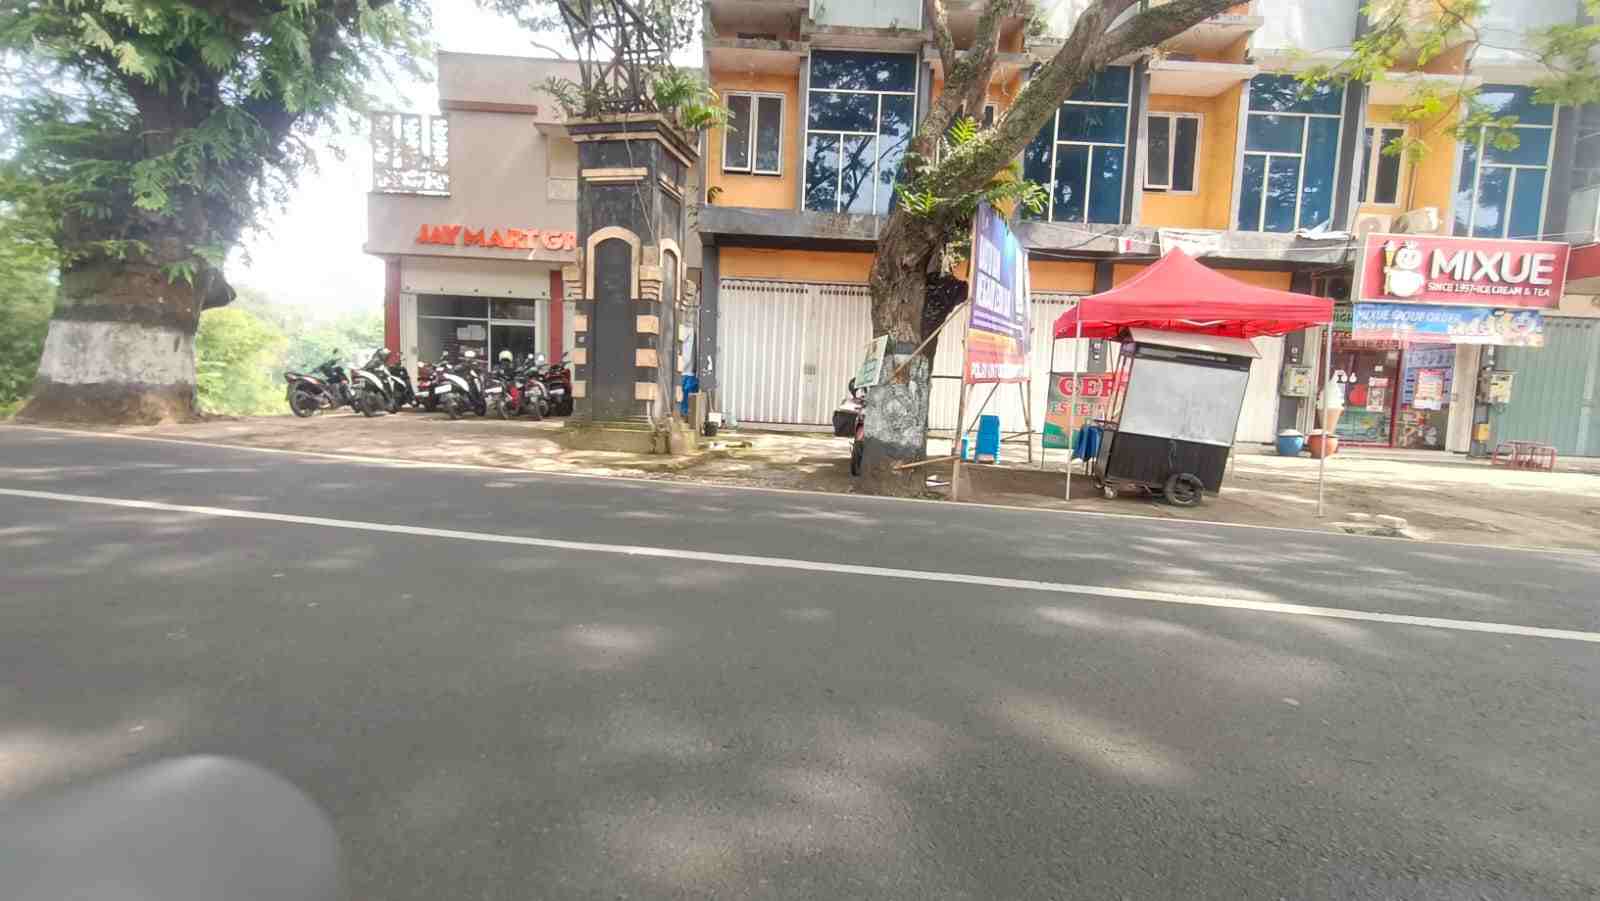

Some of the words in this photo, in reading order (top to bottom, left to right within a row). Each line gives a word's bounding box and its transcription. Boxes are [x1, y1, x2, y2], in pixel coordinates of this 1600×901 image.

[1430, 248, 1556, 285] MIXUE
[1427, 282, 1453, 292] SINCE
[1491, 285, 1522, 295] CREAM
[1534, 287, 1550, 297] TEA
[1358, 310, 1392, 320] MIXUE
